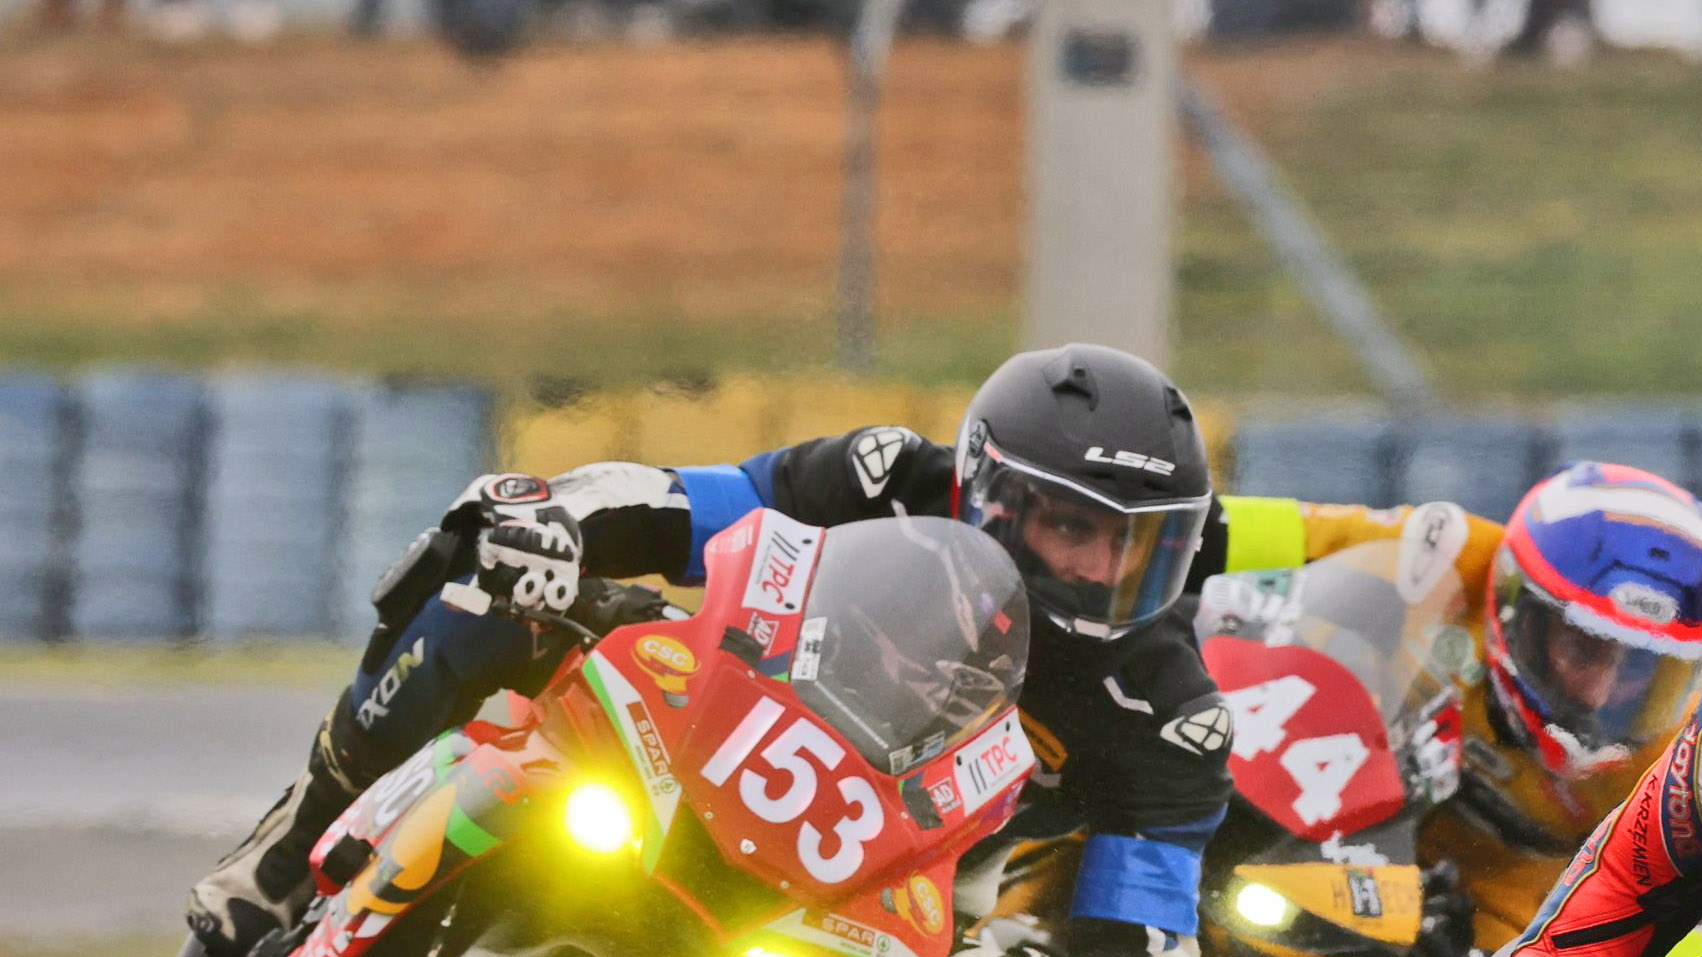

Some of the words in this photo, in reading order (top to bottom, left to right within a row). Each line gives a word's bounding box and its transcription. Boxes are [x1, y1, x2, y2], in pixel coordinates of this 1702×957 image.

[1084, 446, 1176, 476] LS2
[643, 640, 689, 666] CSC
[635, 719, 668, 775] SPAR
[1222, 674, 1371, 826] 44
[700, 696, 884, 884] 153
[821, 917, 874, 946] SPAR
